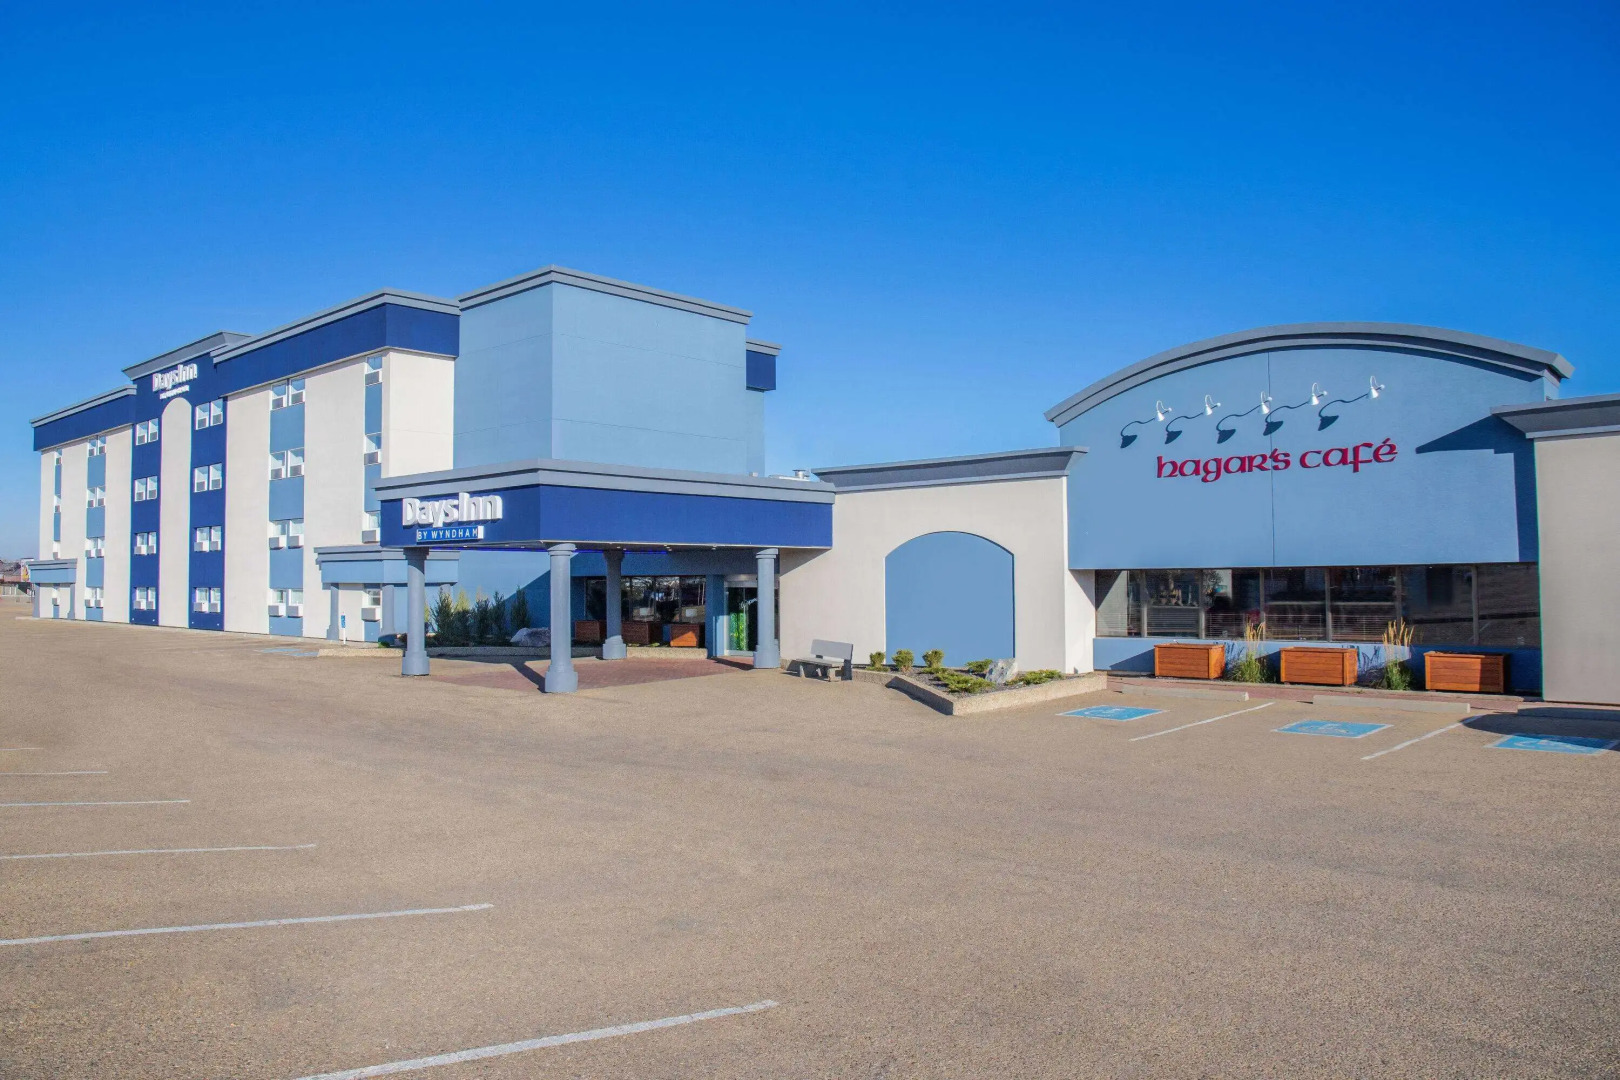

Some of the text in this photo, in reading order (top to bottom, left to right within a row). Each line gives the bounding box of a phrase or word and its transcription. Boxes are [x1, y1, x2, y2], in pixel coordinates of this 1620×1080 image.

[1156, 437, 1399, 483] hagar's café
[417, 528, 478, 540] BY WYNDHAM
